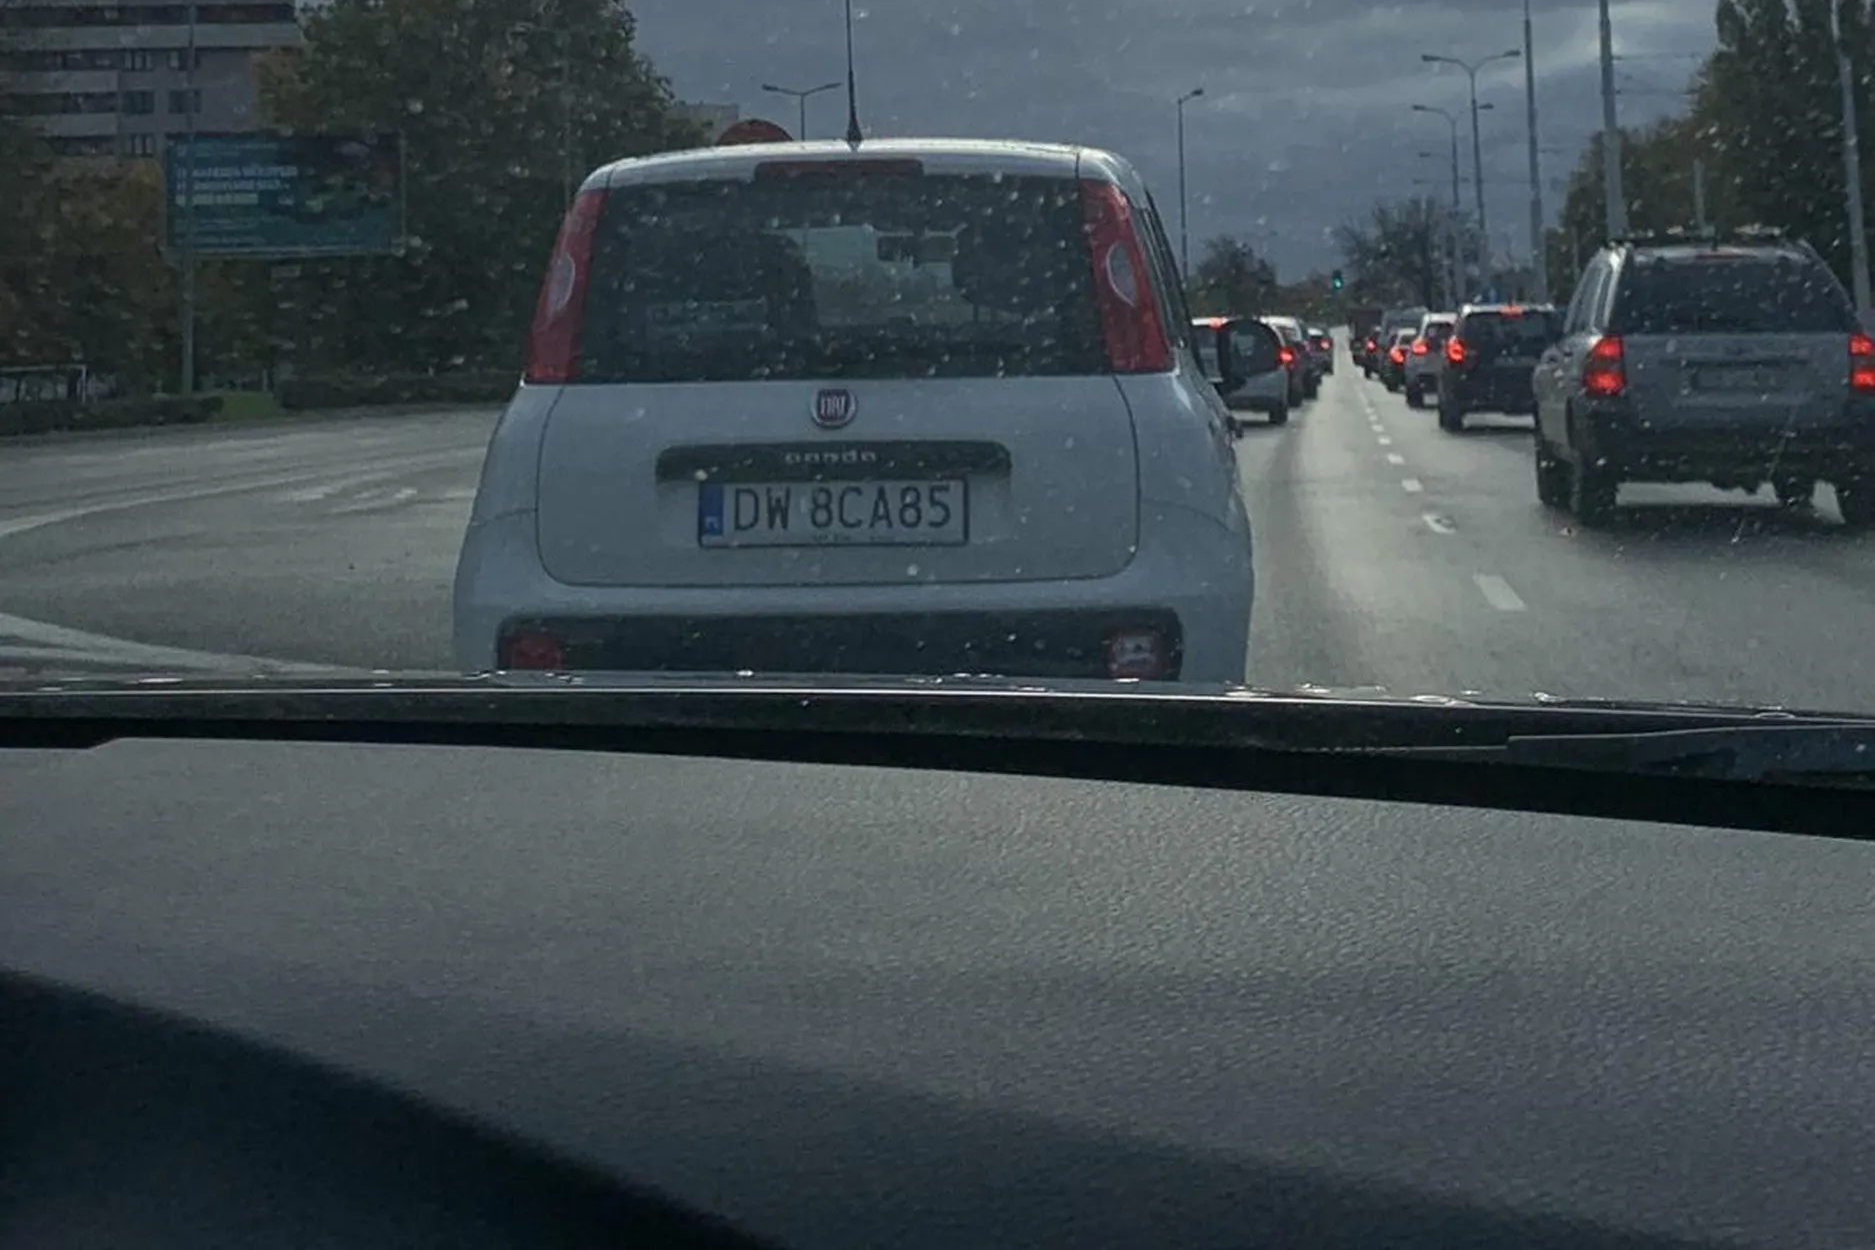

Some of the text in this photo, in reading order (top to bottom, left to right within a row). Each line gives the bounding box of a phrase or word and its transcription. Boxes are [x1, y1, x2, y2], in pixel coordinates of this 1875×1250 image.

[820, 395, 846, 417] FIAT
[733, 485, 951, 531] DW 8CA85
